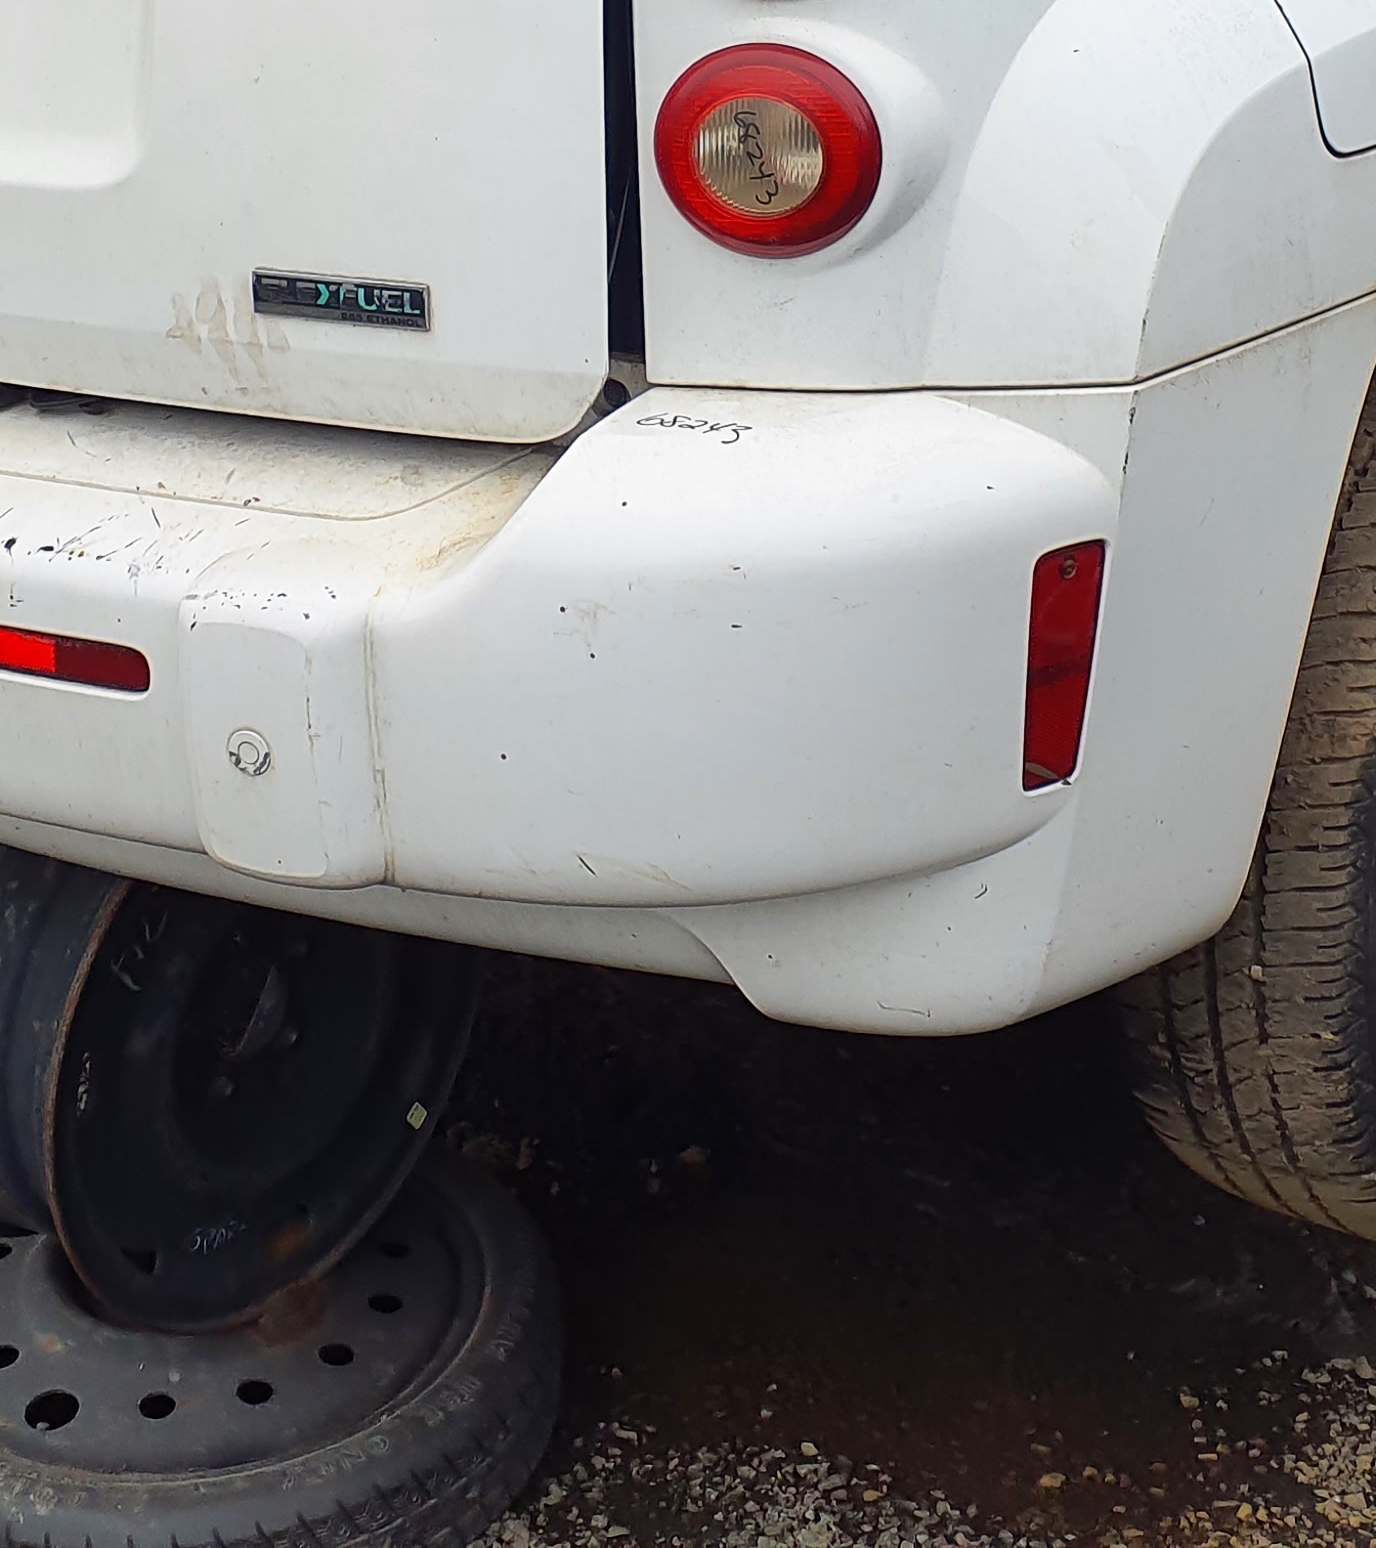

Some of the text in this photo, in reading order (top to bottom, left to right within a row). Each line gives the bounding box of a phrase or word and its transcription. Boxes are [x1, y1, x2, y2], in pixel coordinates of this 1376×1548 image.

[733, 111, 780, 206] 68243
[367, 314, 423, 328] ETHANOL
[636, 412, 753, 444] 68243
